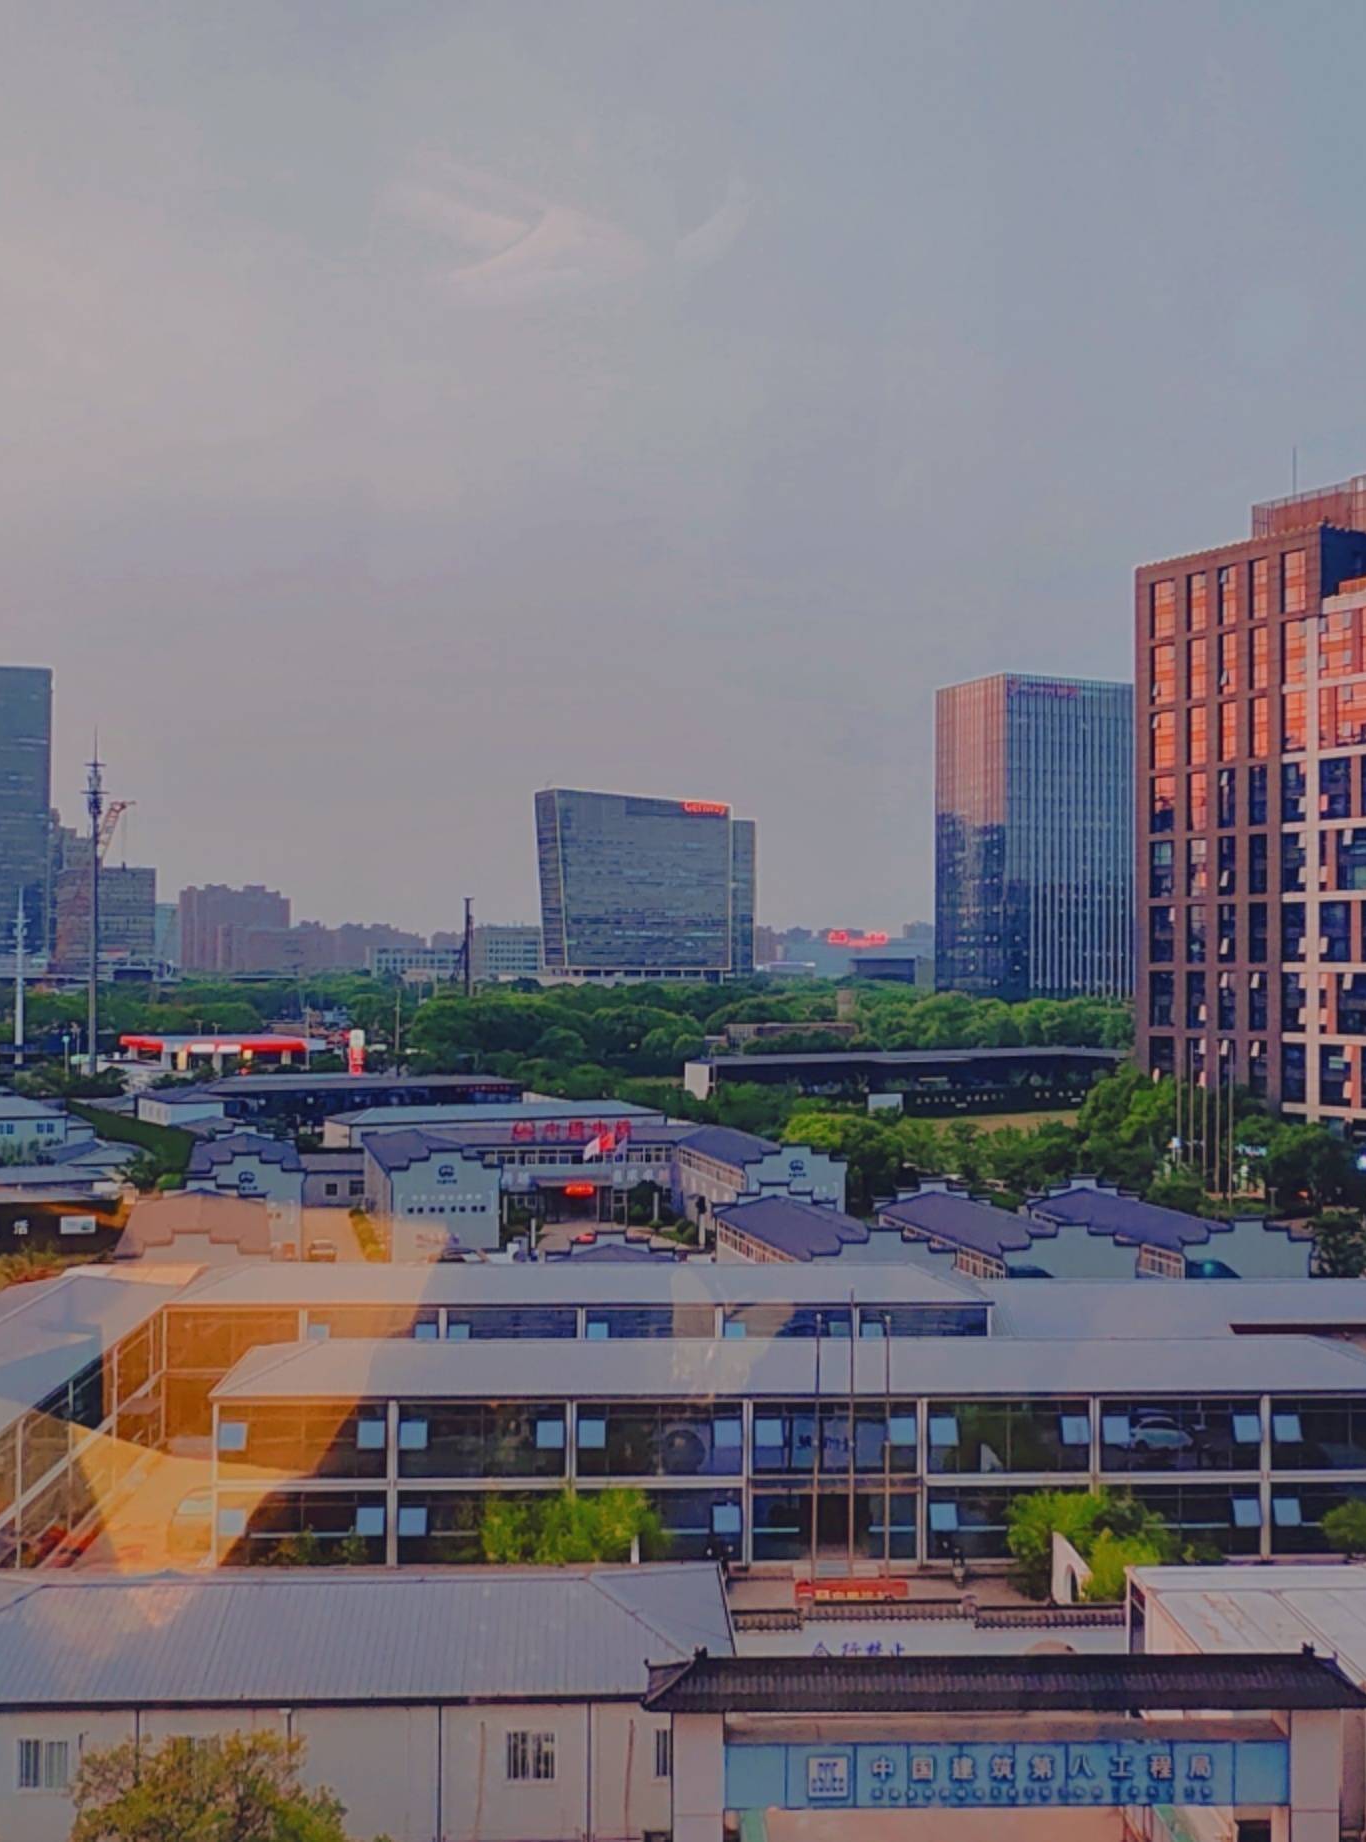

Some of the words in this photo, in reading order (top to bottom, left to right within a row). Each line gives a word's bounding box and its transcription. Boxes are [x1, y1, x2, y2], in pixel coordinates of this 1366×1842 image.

[870, 1753, 1213, 1782] 中国建筑第八工程局
